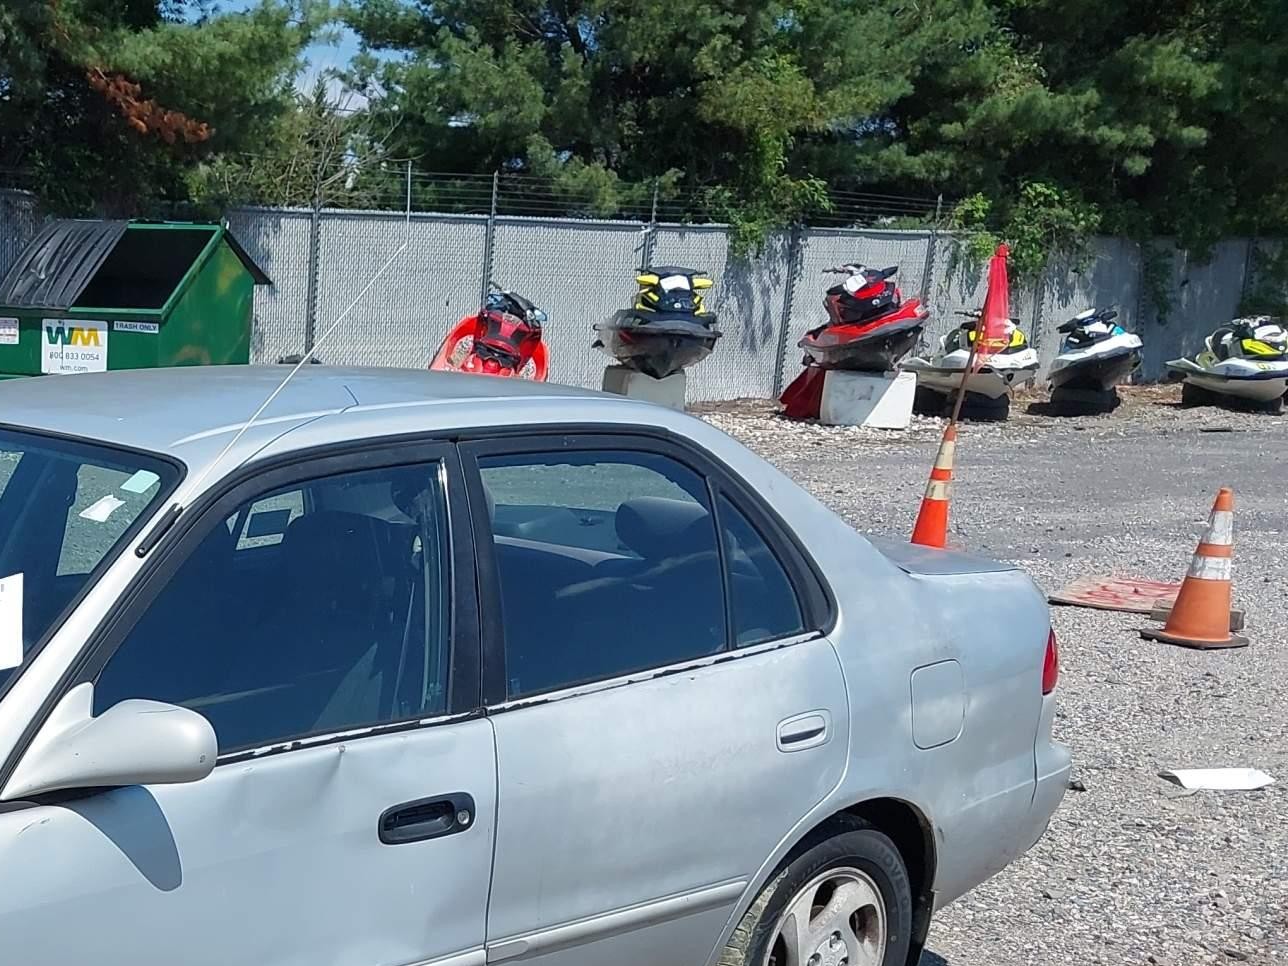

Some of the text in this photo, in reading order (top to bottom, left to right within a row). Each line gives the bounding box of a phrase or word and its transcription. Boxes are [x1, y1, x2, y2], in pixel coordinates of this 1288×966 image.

[115, 322, 157, 331] TRASH ONLY
[46, 326, 100, 346] WM
[65, 352, 79, 360] 833
[80, 353, 100, 361] 0054
